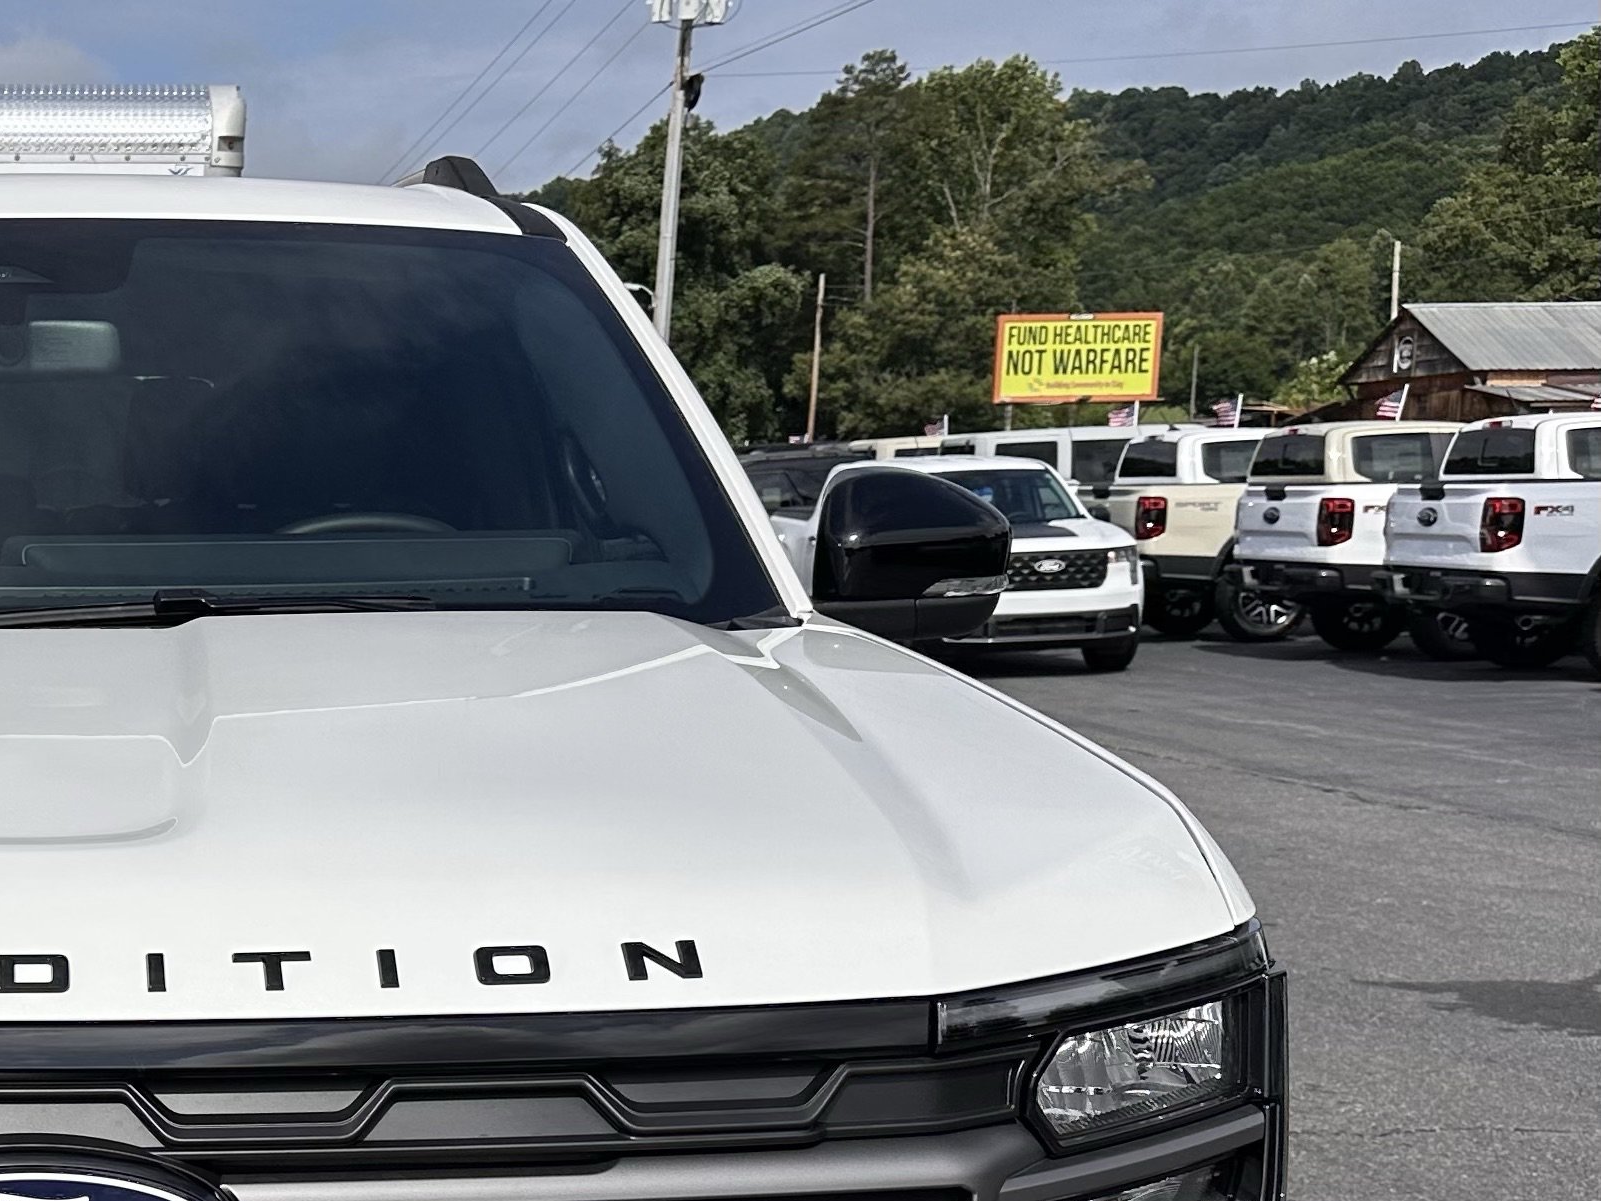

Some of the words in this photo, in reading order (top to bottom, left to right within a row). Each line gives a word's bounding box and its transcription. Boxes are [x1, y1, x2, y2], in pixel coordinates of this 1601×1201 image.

[1007, 325, 1048, 346] FUND
[1052, 323, 1152, 345] HEALTHCARE
[1006, 349, 1047, 376] NOT
[1052, 347, 1150, 375] WARFARE
[1534, 505, 1574, 515] FX4
